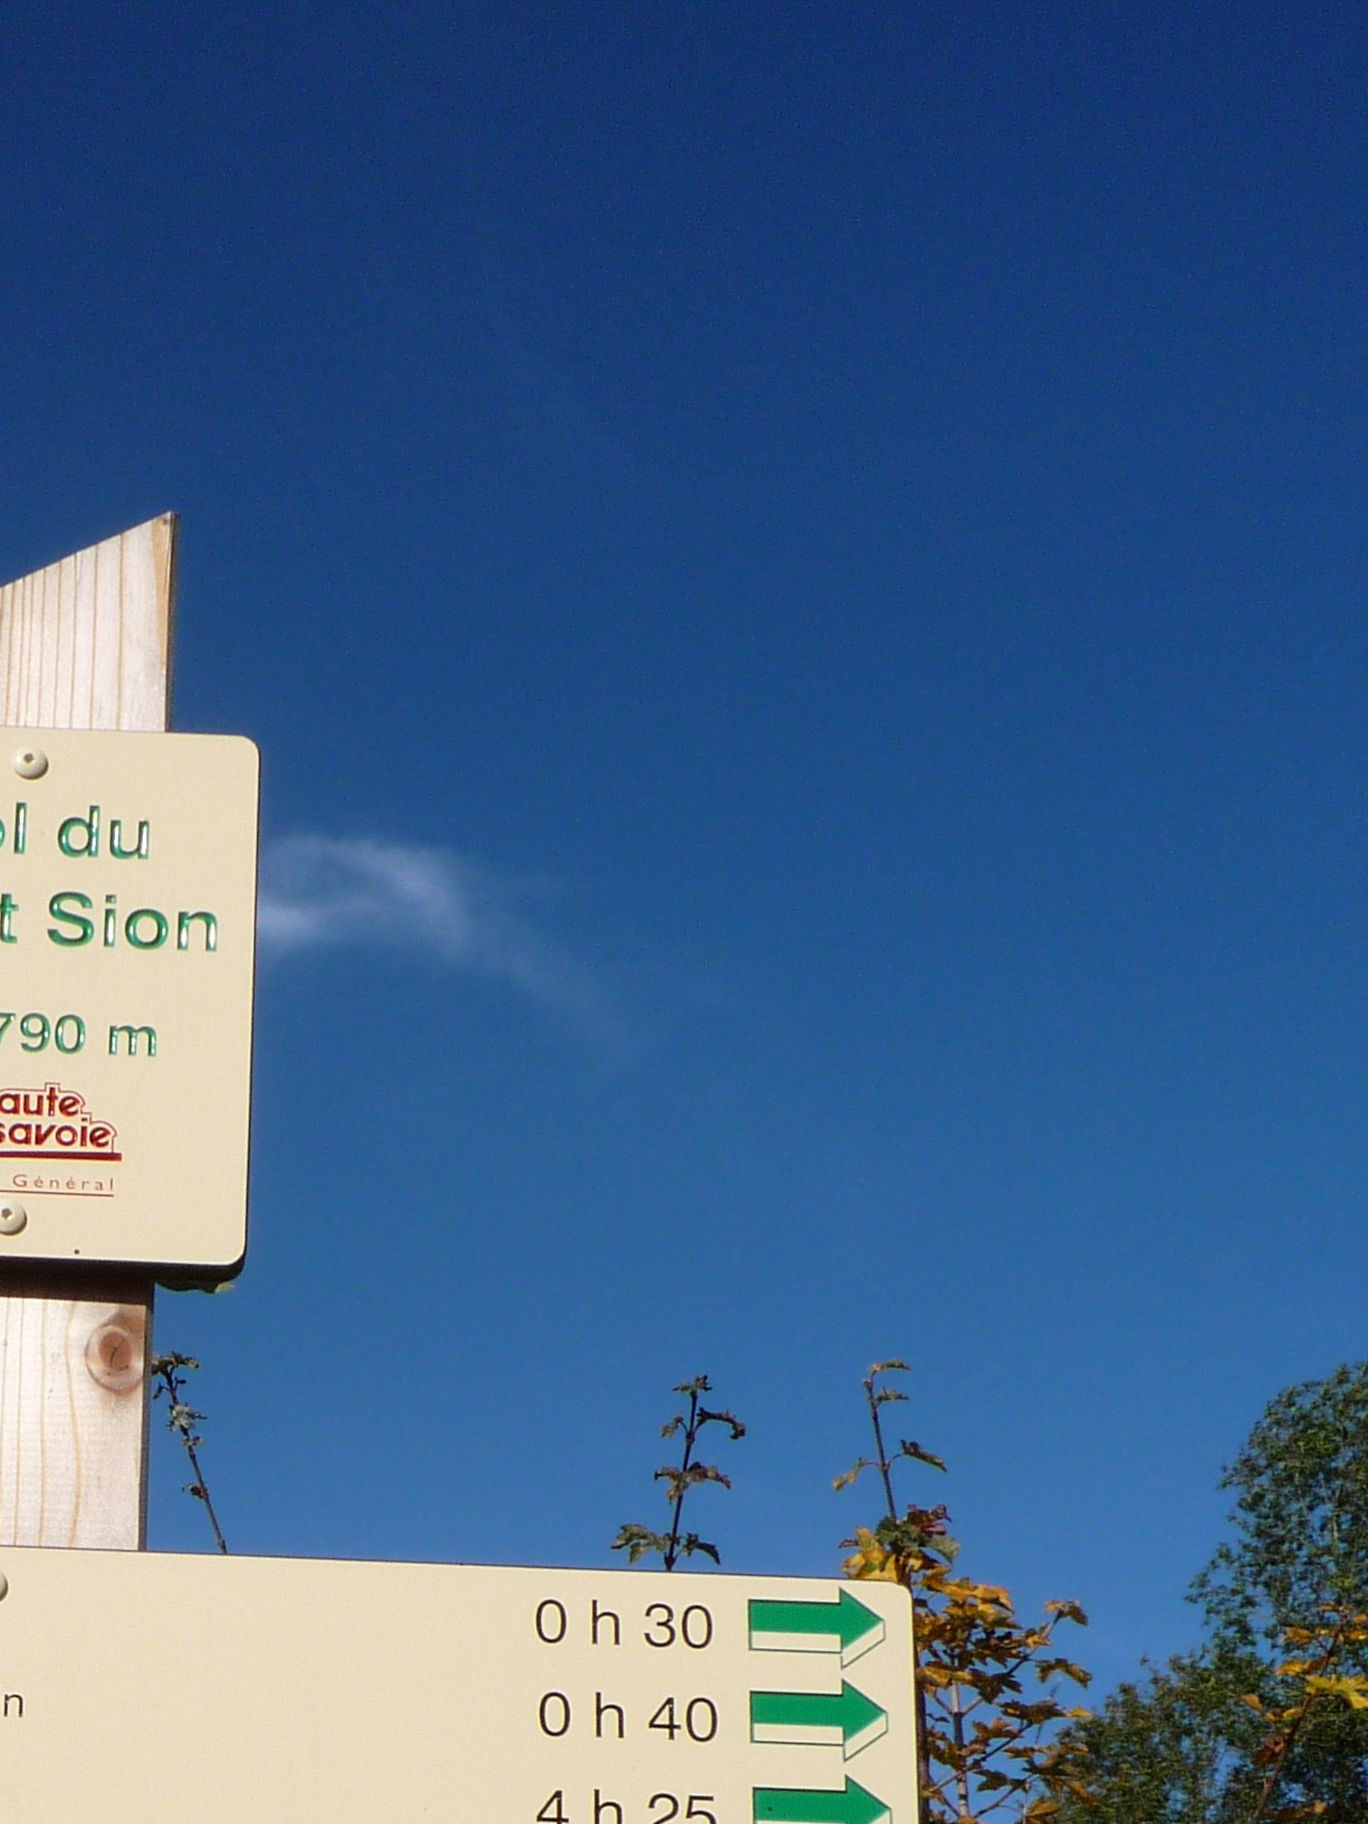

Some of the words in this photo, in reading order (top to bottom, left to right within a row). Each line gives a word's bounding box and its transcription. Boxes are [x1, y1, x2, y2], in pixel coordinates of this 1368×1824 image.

[58, 805, 149, 859] du
[47, 892, 217, 952] Sion
[109, 1025, 156, 1056] m
[13, 1174, 114, 1191] Général
[536, 1599, 567, 1644] 0
[592, 1599, 620, 1645] h
[644, 1603, 712, 1649] 30
[539, 1692, 570, 1737] 0
[595, 1692, 624, 1738] h
[648, 1697, 717, 1742] 40
